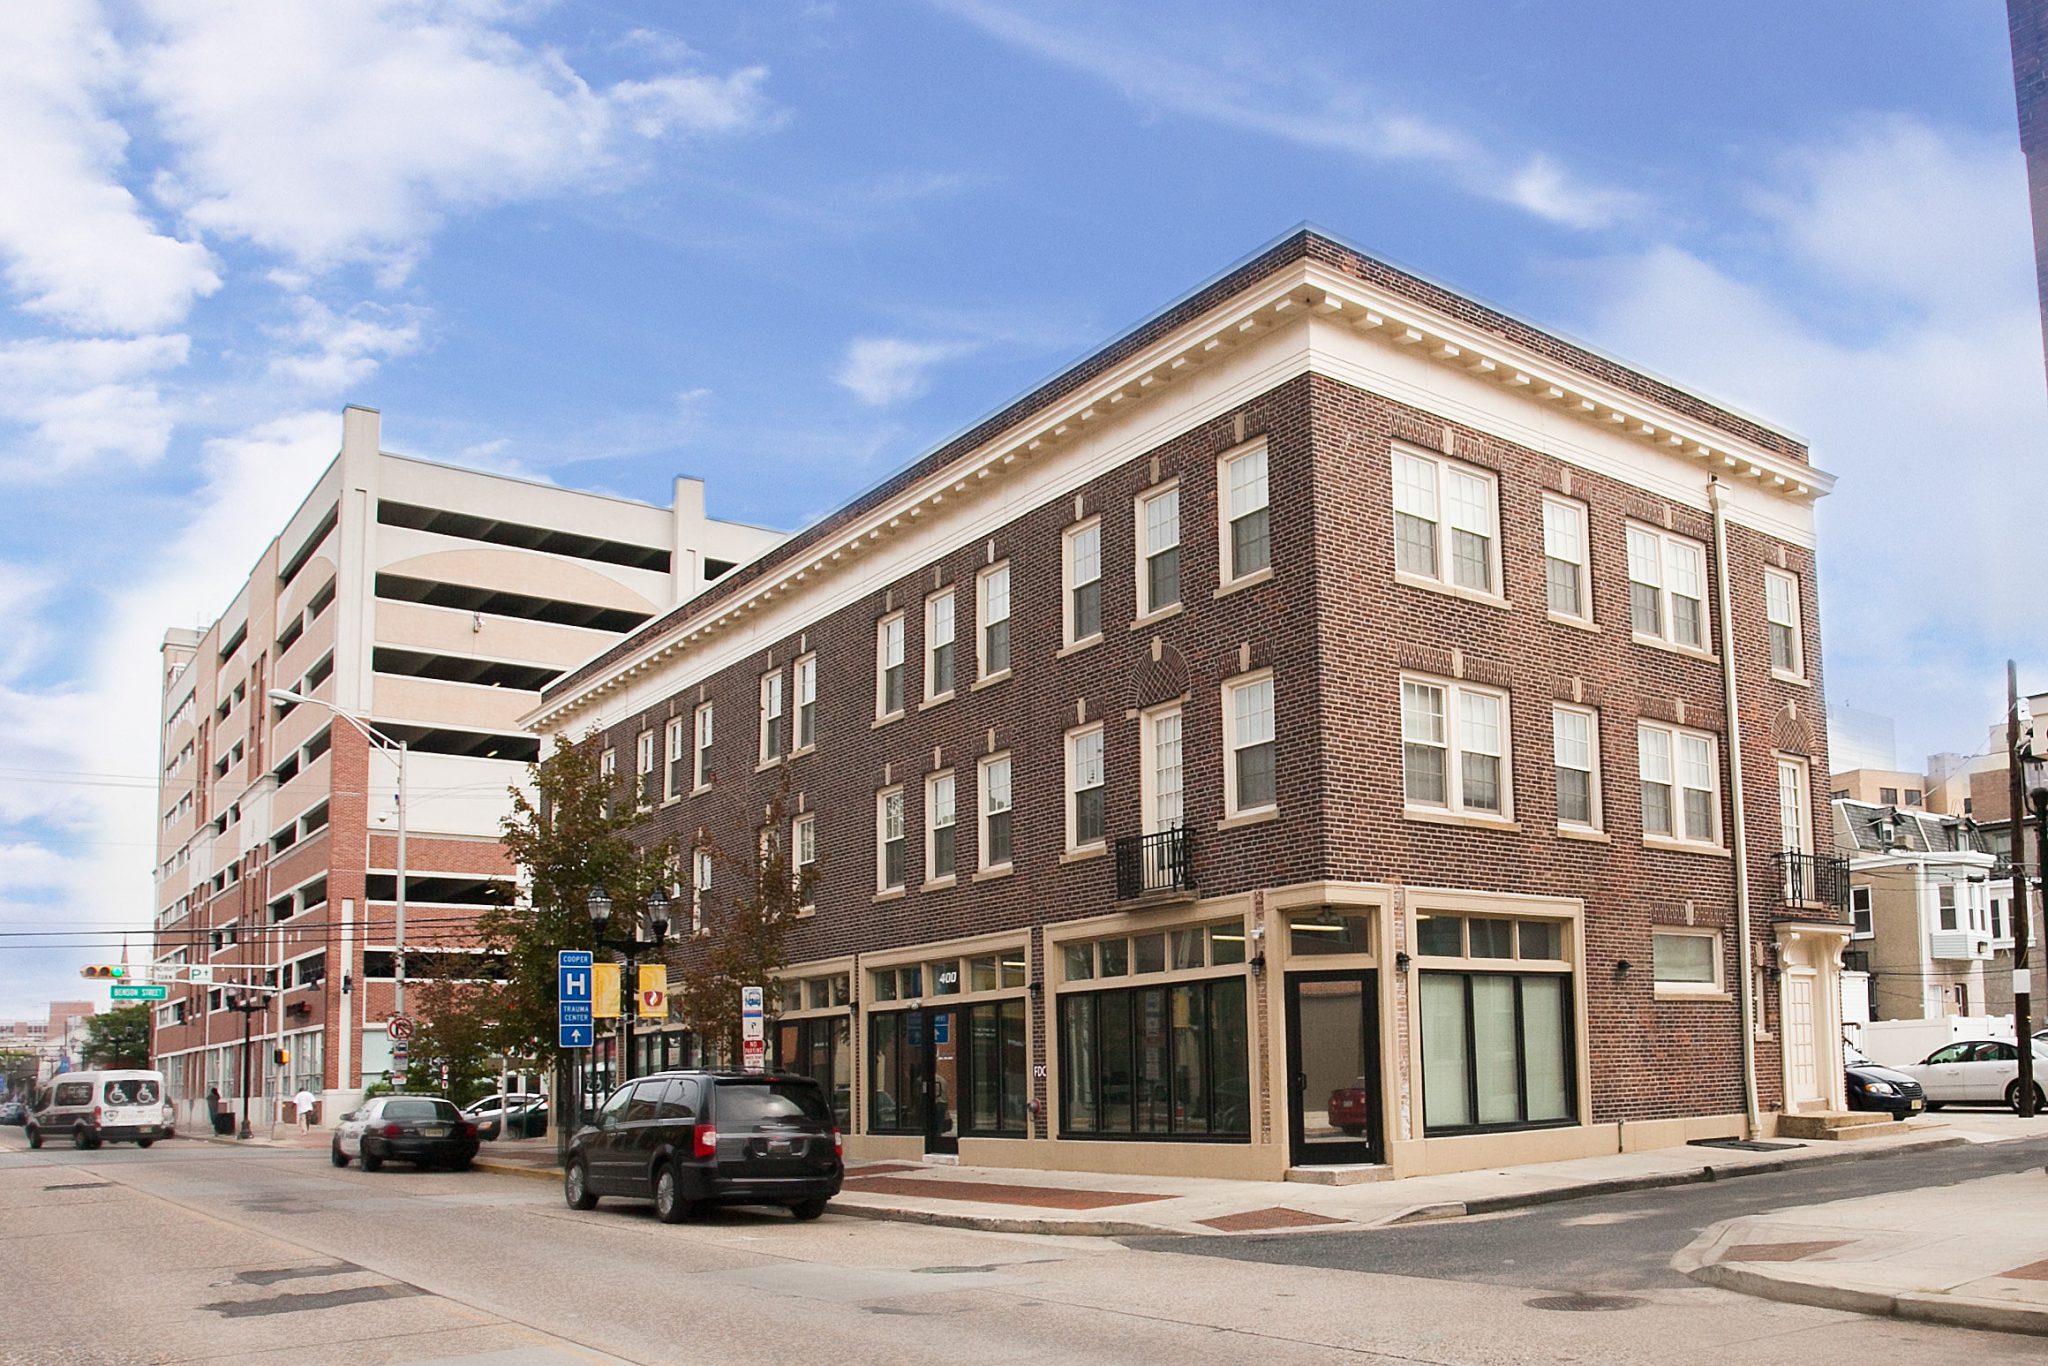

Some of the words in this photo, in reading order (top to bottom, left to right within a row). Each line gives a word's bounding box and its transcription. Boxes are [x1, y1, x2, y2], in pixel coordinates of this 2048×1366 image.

[563, 955, 588, 963] COOPER
[939, 971, 957, 984] 400
[567, 973, 585, 996] H
[142, 988, 161, 997] STREET
[563, 1005, 589, 1013] TRAUMA
[564, 1014, 588, 1022] CENTER
[1034, 1065, 1047, 1077] FDC
